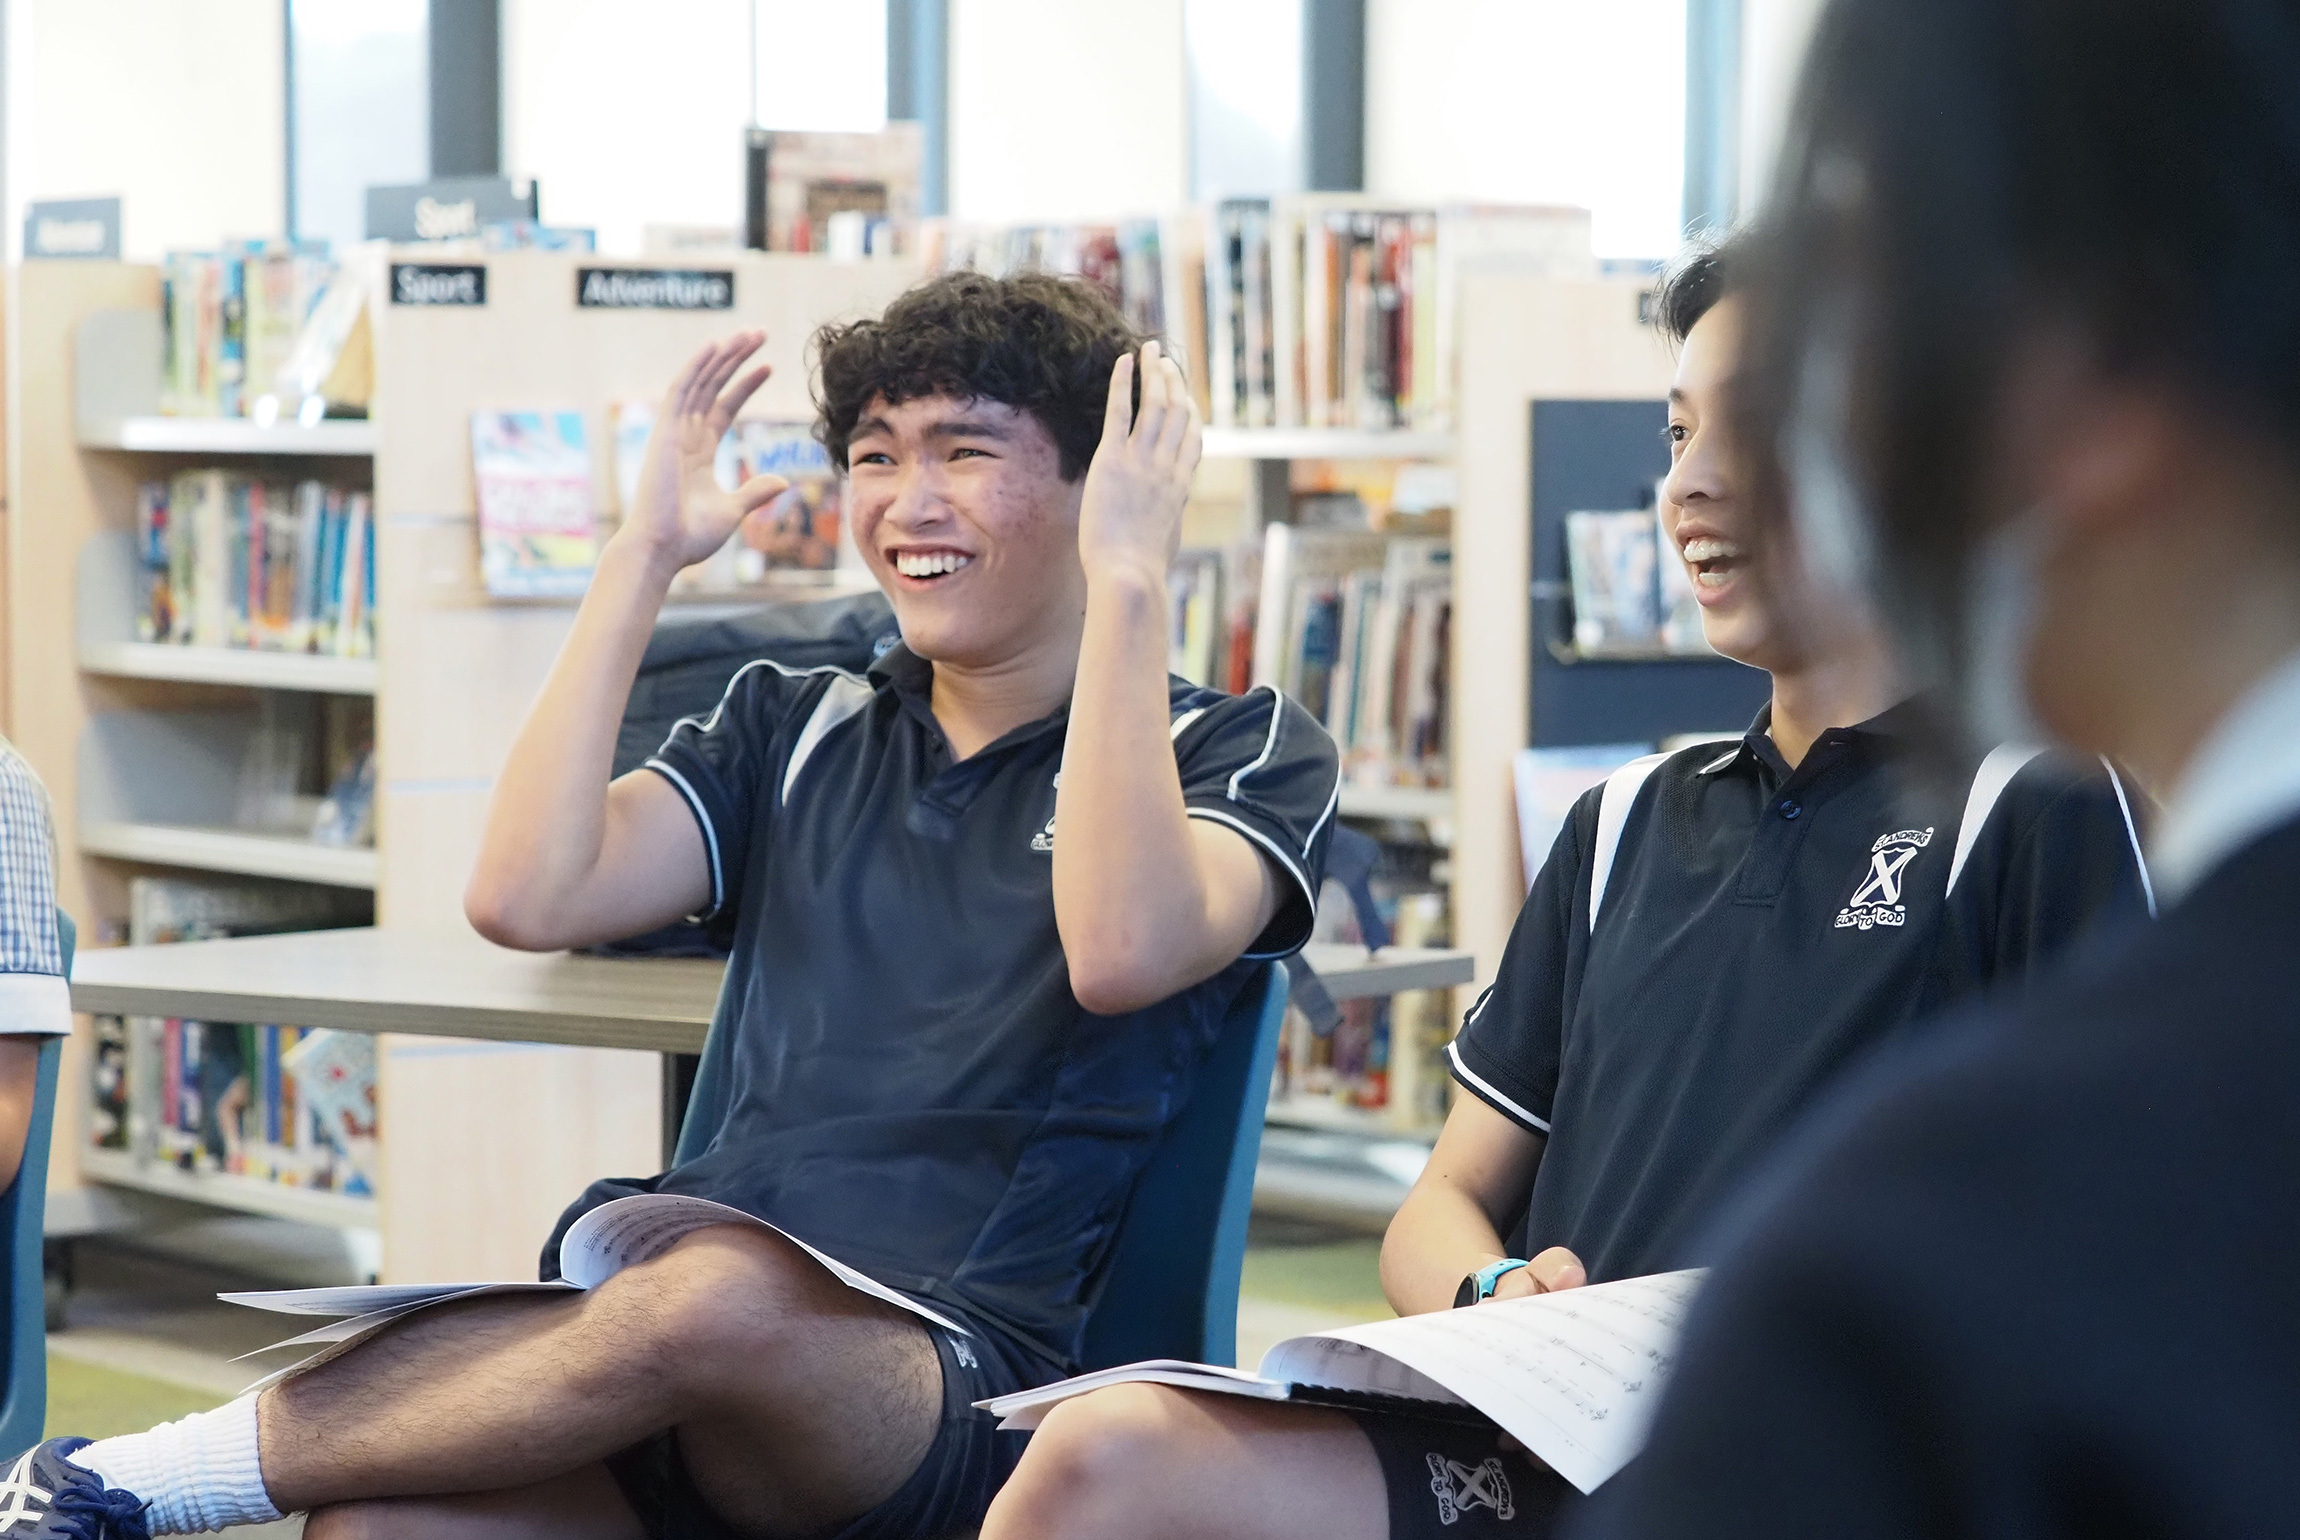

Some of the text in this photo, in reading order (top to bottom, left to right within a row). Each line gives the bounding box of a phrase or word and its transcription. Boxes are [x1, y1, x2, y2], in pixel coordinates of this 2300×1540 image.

[397, 266, 476, 303] Sport
[582, 270, 729, 307] Adventure
[1859, 917, 1873, 928] TO
[1879, 911, 1903, 924] GOD
[1433, 1479, 1444, 1492] TO
[1441, 1498, 1451, 1519] GOD
